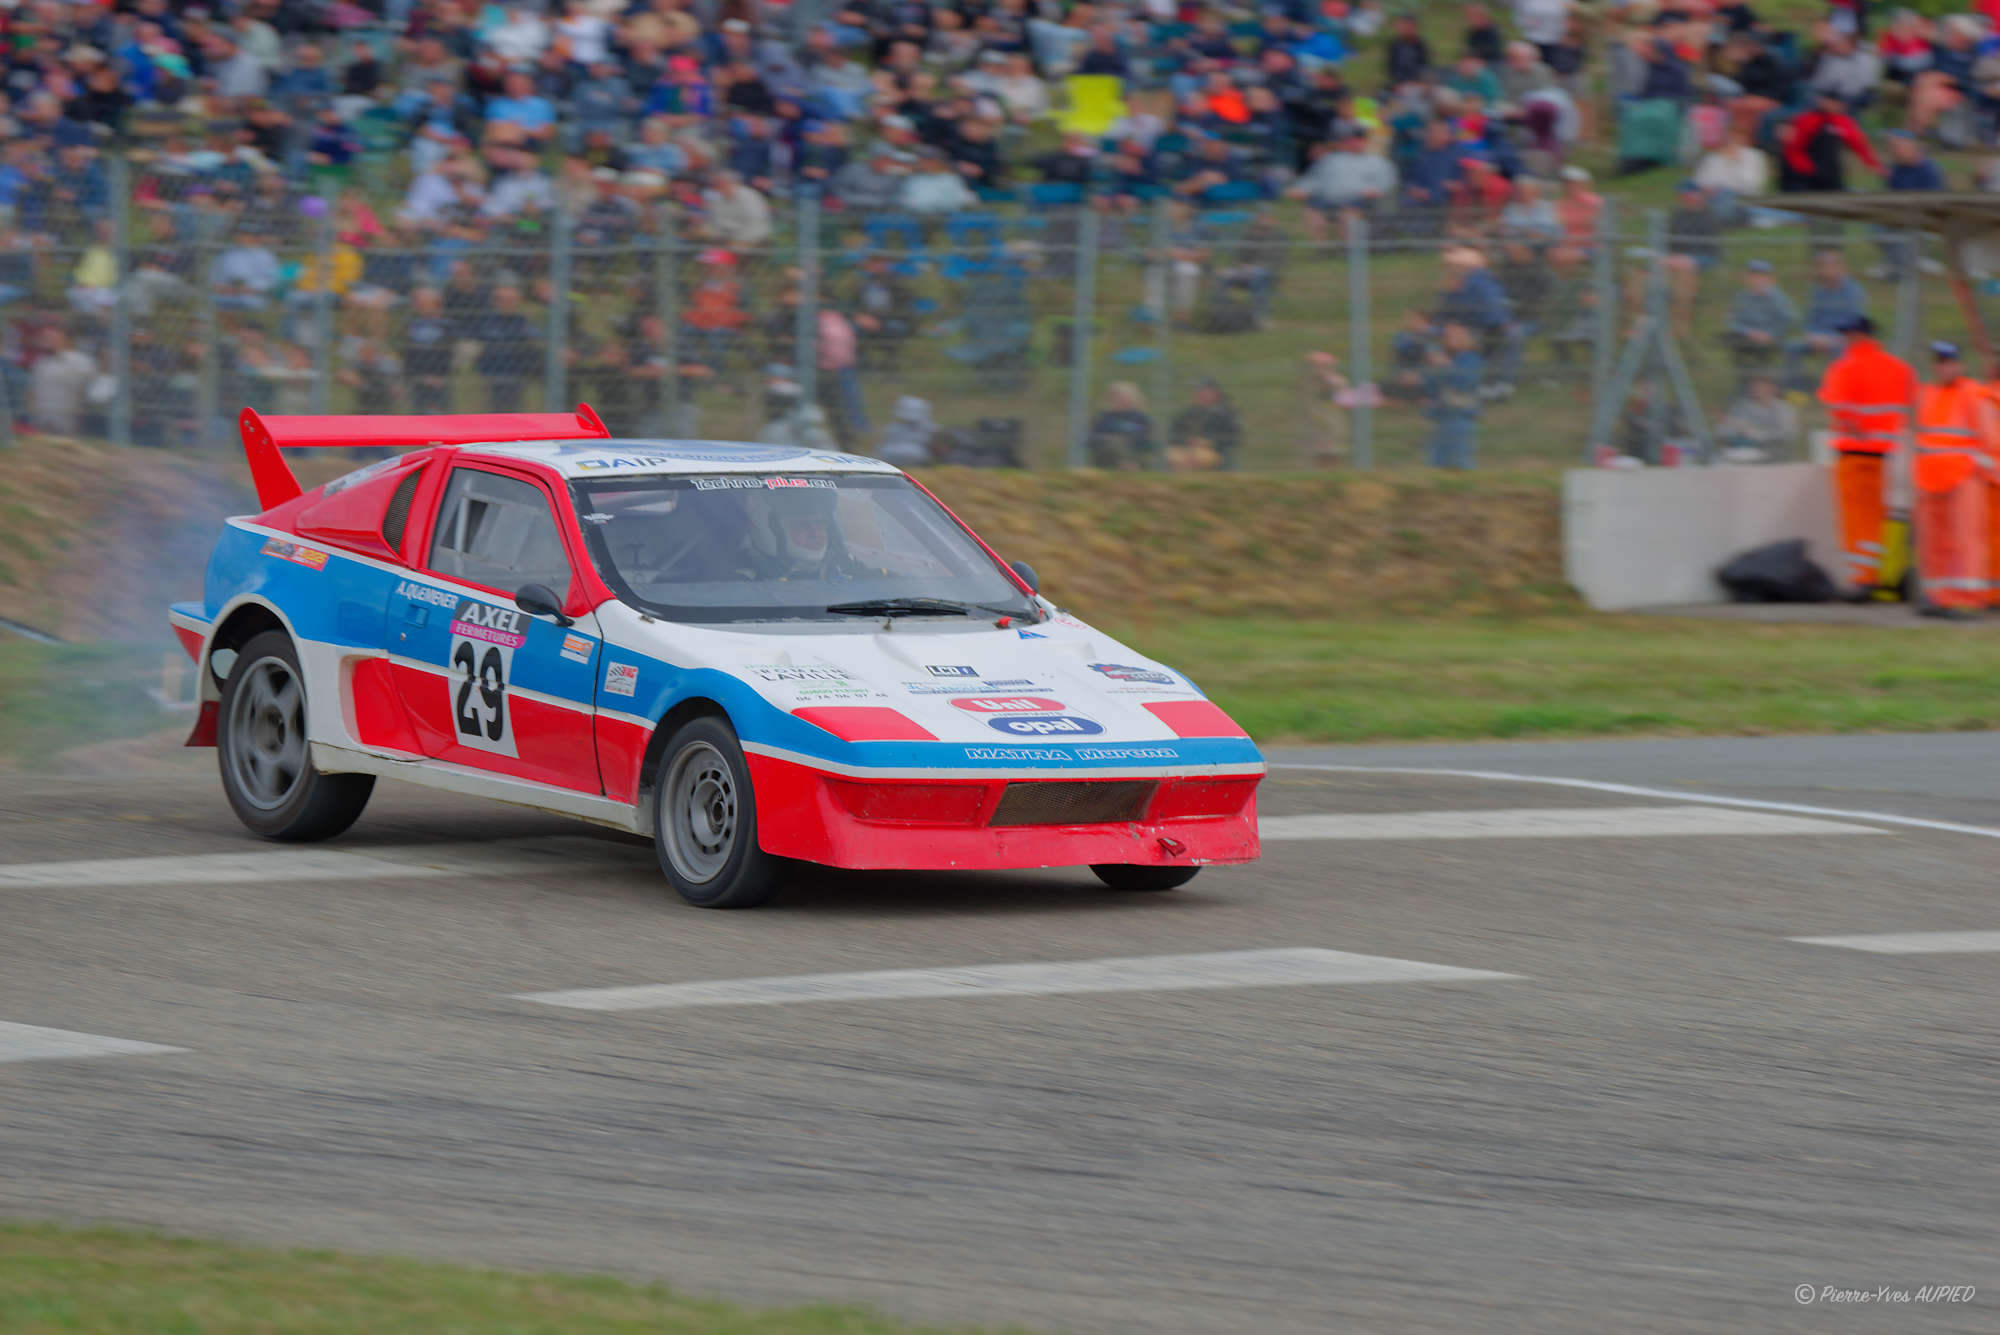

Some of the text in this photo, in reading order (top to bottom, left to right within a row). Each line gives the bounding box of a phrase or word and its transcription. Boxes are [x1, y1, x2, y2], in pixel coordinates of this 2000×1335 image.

[461, 601, 521, 635] AXEL
[455, 622, 519, 648] FERMETURES
[454, 641, 505, 742] 29
[971, 699, 1042, 711] Unil
[1008, 717, 1085, 735] opal
[964, 748, 1073, 761] MATRA
